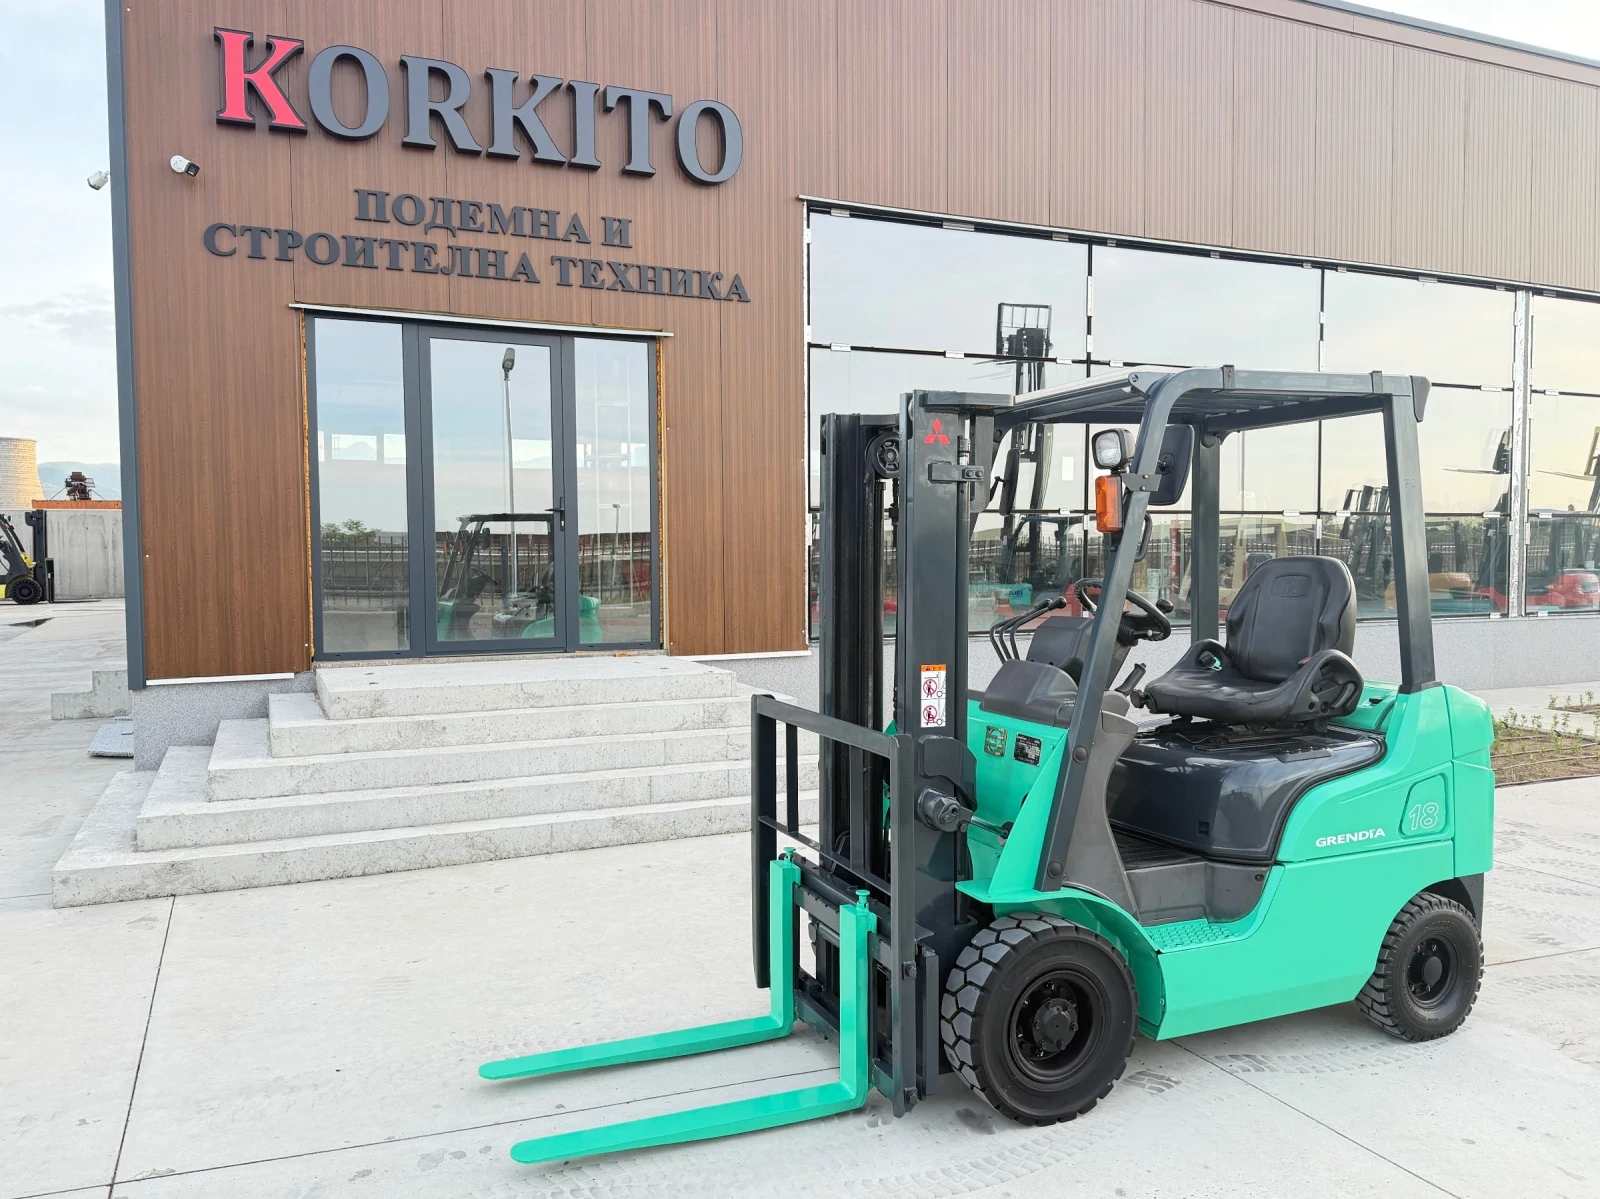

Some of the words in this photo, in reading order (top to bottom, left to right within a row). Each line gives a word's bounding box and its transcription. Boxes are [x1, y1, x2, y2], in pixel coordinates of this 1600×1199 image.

[213, 26, 743, 186] KORKITO
[354, 188, 591, 244] ПОДЕМНА
[601, 215, 633, 248] И
[203, 222, 540, 283] СТРОИТЕЛНА
[551, 254, 751, 302] ТЕХНИКА
[1408, 802, 1438, 831] 18
